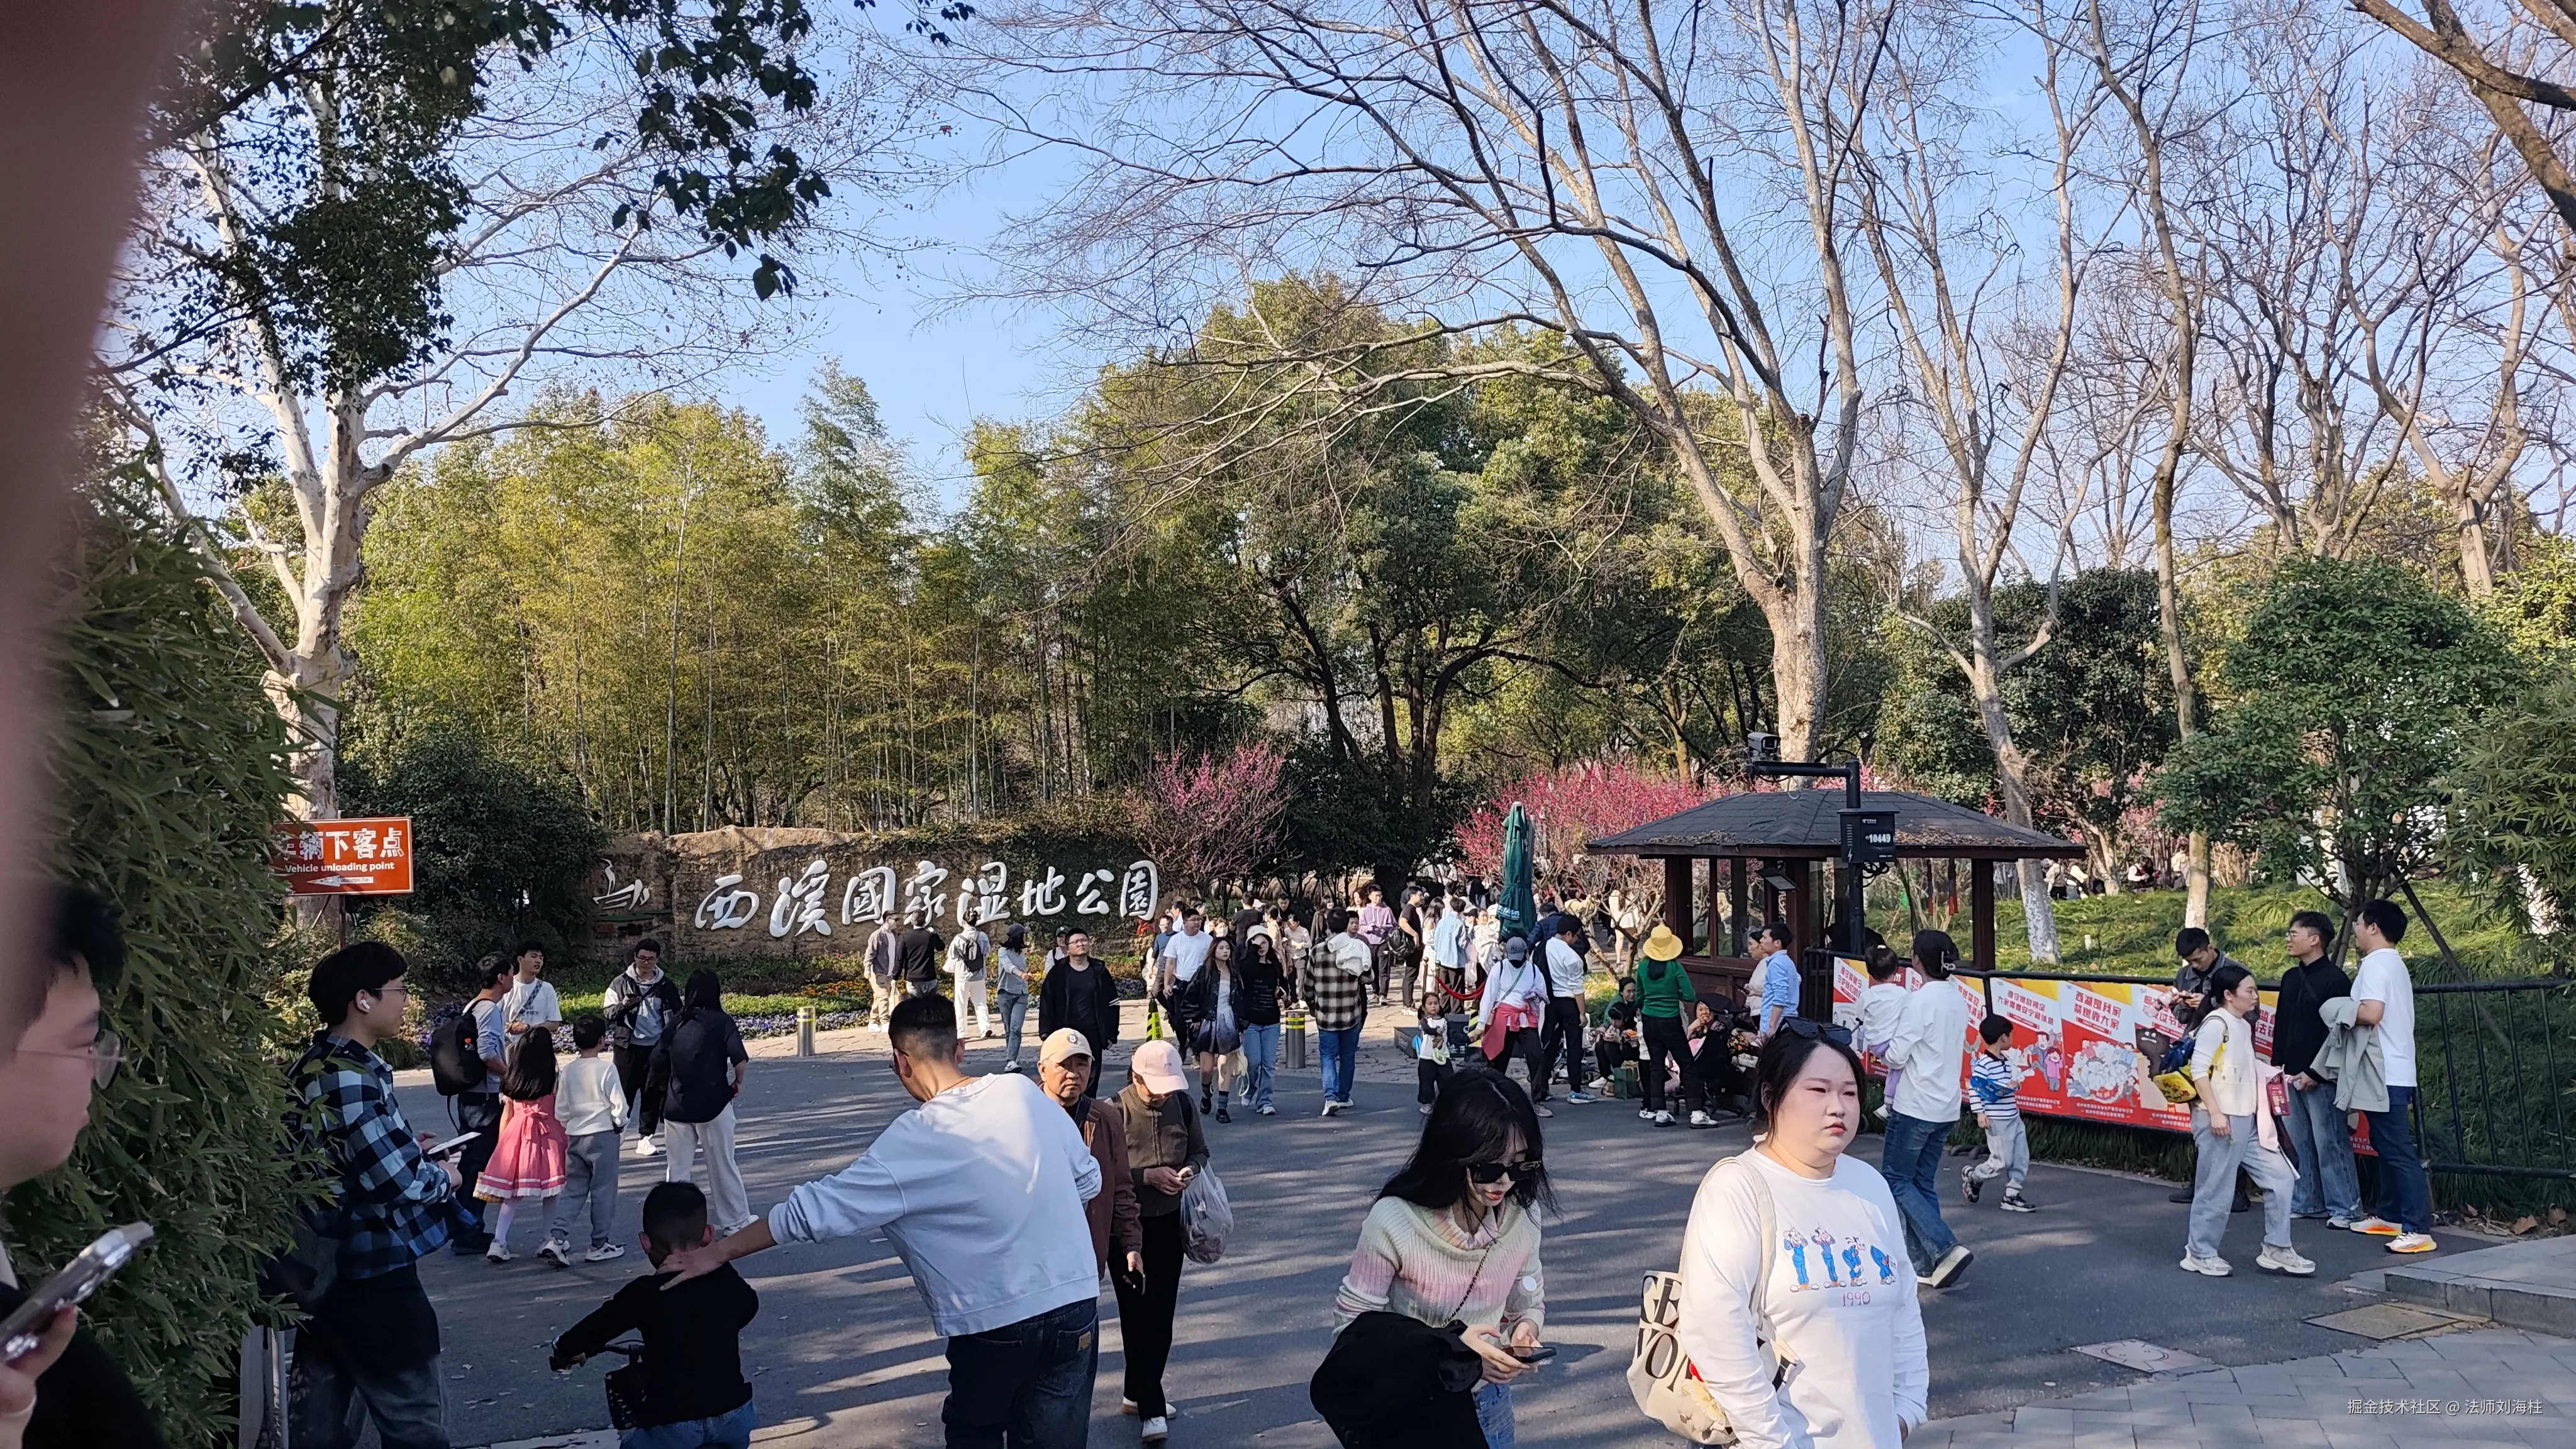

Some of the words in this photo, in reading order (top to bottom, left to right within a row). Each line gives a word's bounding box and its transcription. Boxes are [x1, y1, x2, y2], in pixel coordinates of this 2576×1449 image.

[1869, 833, 1890, 843] 10449
[285, 863, 318, 873] Vehicle
[321, 862, 367, 873] unloading
[369, 862, 395, 871] point
[1843, 1292, 1870, 1307] 1990
